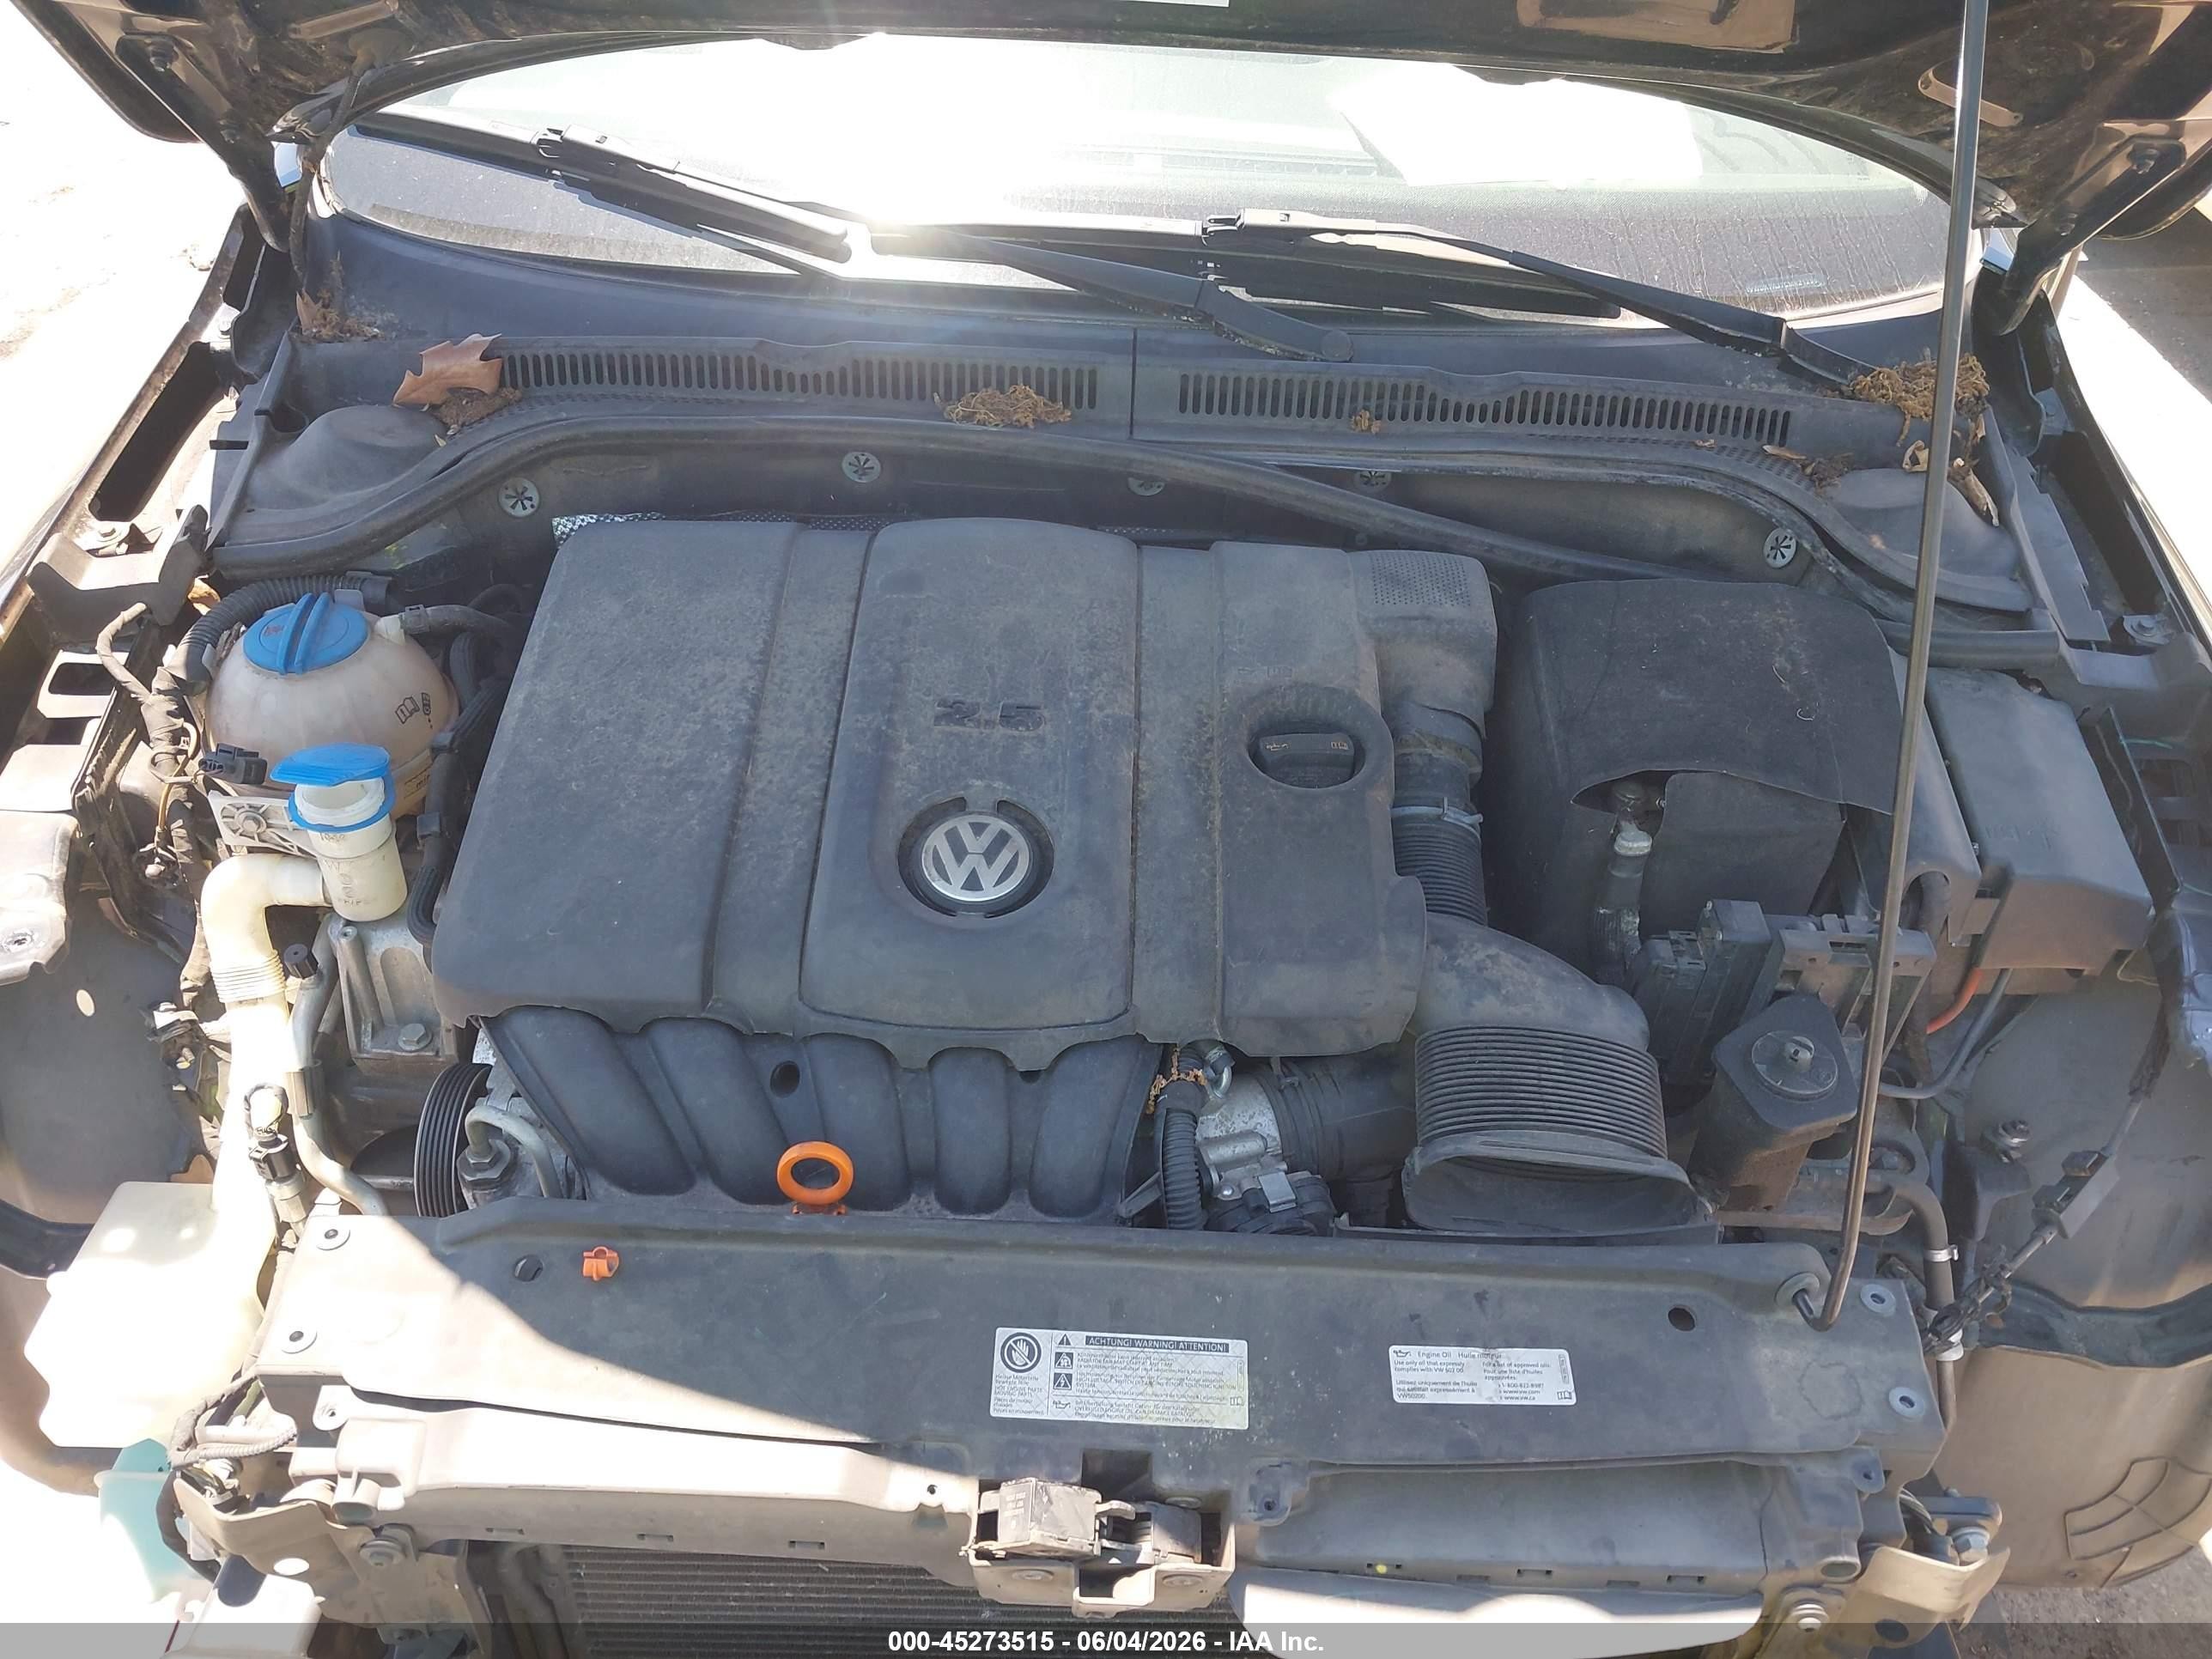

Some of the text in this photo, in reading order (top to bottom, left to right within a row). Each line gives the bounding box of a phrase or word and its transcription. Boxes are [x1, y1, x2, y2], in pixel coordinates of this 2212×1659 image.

[934, 700, 1046, 732] 2.5
[924, 816, 1028, 901] VW
[1089, 1336, 1227, 1352] ACHTUNG! WARNING! ATTENTION!
